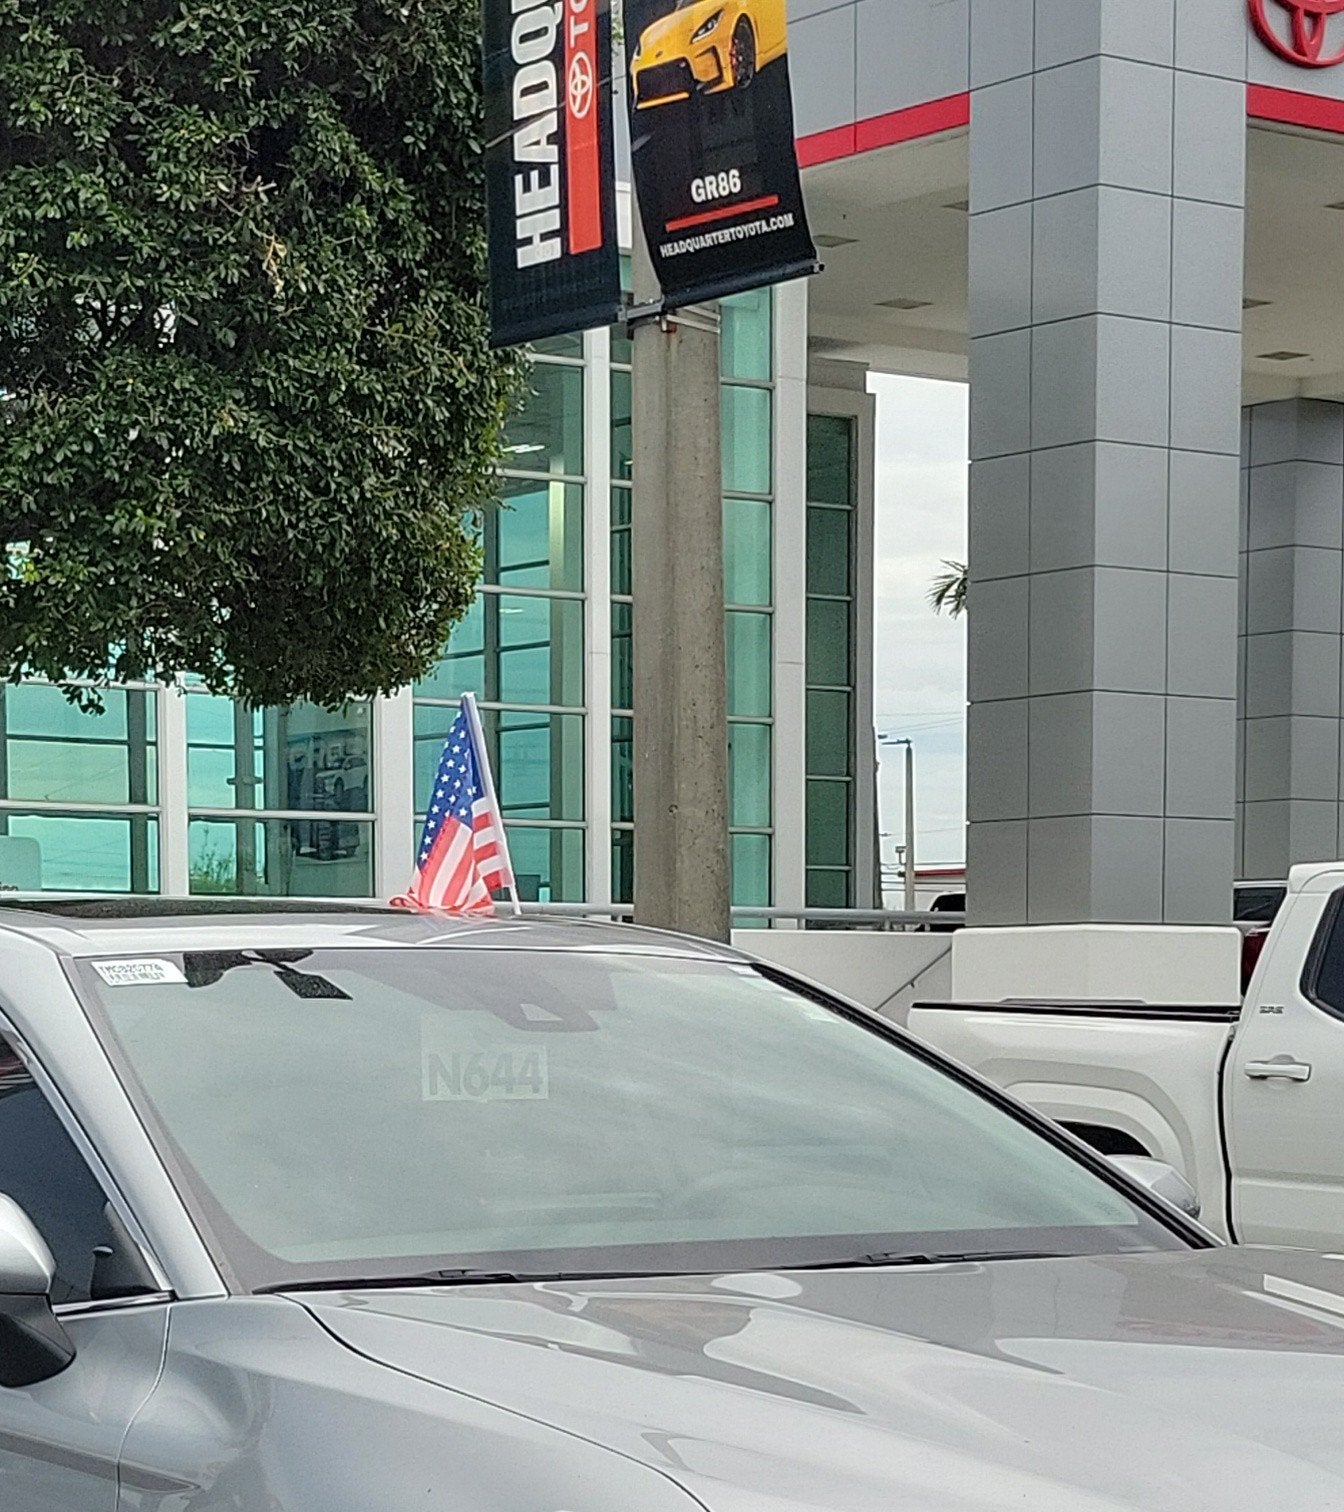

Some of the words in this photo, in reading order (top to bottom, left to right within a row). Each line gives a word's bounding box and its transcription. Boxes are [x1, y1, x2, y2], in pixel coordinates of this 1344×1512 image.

[511, 0, 562, 268] HEADQ
[690, 168, 742, 203] GR86
[659, 212, 795, 258] HEADQUARTERTOYOTA.COM
[428, 1050, 544, 1097] N644
